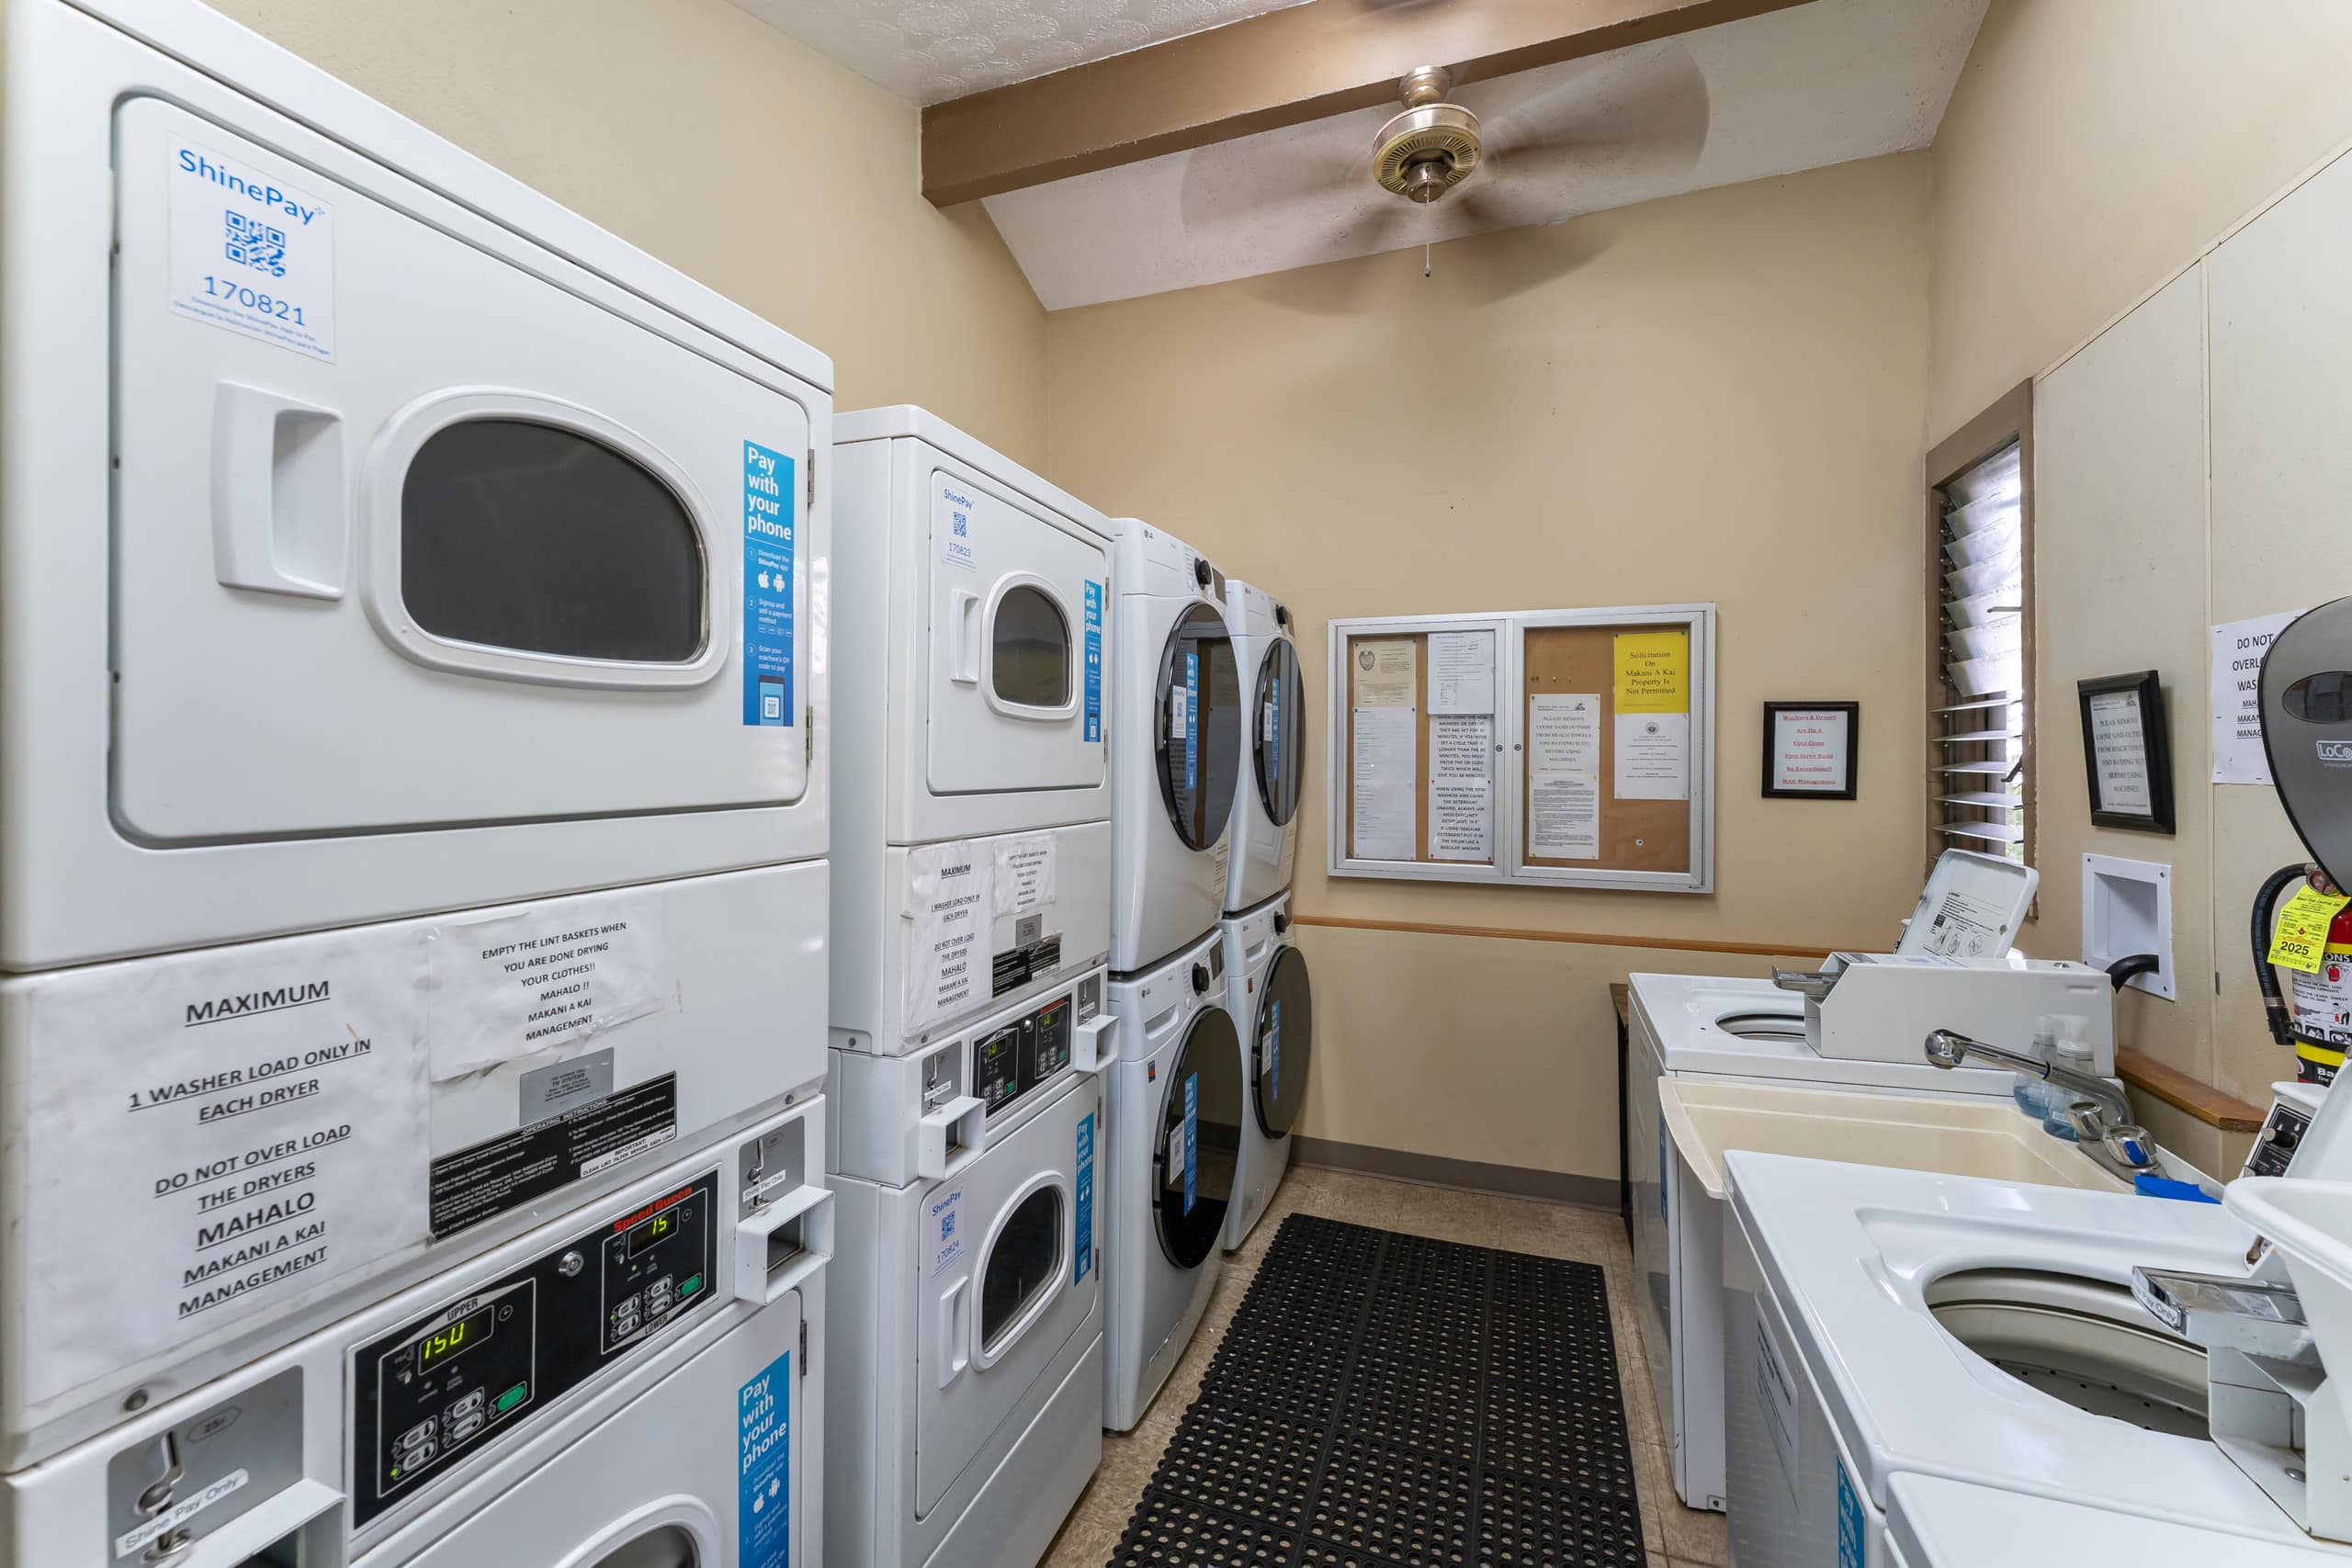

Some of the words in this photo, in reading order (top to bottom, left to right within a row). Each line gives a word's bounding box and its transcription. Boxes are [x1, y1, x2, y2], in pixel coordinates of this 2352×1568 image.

[179, 150, 313, 225] ShinePay
[204, 276, 305, 326] 170821
[748, 446, 775, 475] Pay
[748, 474, 779, 496] with
[748, 494, 780, 515] your
[944, 489, 972, 511] ShinePay
[748, 513, 792, 540] phone
[1086, 621, 1101, 634] phone
[2237, 638, 2250, 649] DO
[2253, 634, 2274, 646] NOT
[2233, 657, 2264, 671] OVERL
[2237, 679, 2257, 692] WAS
[942, 864, 970, 876] MAXIMUM
[934, 900, 952, 910] WASHER
[953, 897, 964, 907] LOAD
[955, 909, 968, 919] DRYER
[481, 945, 516, 960] EMPTY
[518, 941, 537, 952] THE
[540, 935, 560, 948] LINT
[562, 928, 599, 942] BASKETS
[601, 922, 627, 934] WHEN
[942, 940, 951, 948] NOT
[952, 937, 964, 945] OVER
[2280, 942, 2310, 955] 2025
[504, 961, 526, 973] YOU
[527, 956, 547, 968] ARE
[549, 951, 574, 964] DONE
[577, 942, 609, 957] DRYING
[2323, 953, 2350, 963] ONS
[522, 974, 548, 987] YOUR
[552, 963, 595, 981] CLOTHES!!
[941, 963, 967, 977] MAHALO
[186, 980, 331, 1023] MAXIMUM
[540, 984, 581, 1001] MAHALO
[937, 989, 969, 1006] MANAGEMENT
[528, 1005, 567, 1021] MAKANI
[570, 1001, 575, 1010] A
[577, 998, 592, 1009] KAI
[526, 1014, 594, 1042] MANAGEMENT
[129, 1093, 141, 1109] 1
[149, 1069, 243, 1103] WASHER
[249, 1056, 300, 1079] LOAD
[304, 1043, 349, 1065] ONLY
[355, 1038, 371, 1054] IN
[2317, 1067, 2334, 1077] Ba
[198, 1096, 254, 1122] EACH
[260, 1079, 320, 1105] DRYER
[154, 1173, 188, 1195] DO
[195, 1156, 240, 1180] NOT
[244, 1140, 297, 1166] OVER
[302, 1124, 352, 1146] LOAD
[198, 1185, 237, 1211] THE
[243, 1161, 316, 1196] DRYERS
[933, 1190, 961, 1216] ShinePay
[197, 1192, 315, 1247] MAHALO
[613, 1210, 653, 1233] Speed
[652, 1217, 667, 1235] 15
[184, 1242, 271, 1284] MAKANI
[276, 1235, 289, 1251] A
[295, 1220, 325, 1241] KAI
[178, 1246, 329, 1316] MANAGEMENT
[447, 1298, 478, 1321] UPPER
[645, 1314, 668, 1335] LOWER
[742, 1374, 770, 1406] Pay
[742, 1394, 774, 1428] with
[742, 1411, 775, 1454] your
[743, 1422, 786, 1474] phone
[125, 1517, 170, 1550] Shine
[175, 1502, 201, 1520] Pay
[206, 1479, 241, 1501] Only
